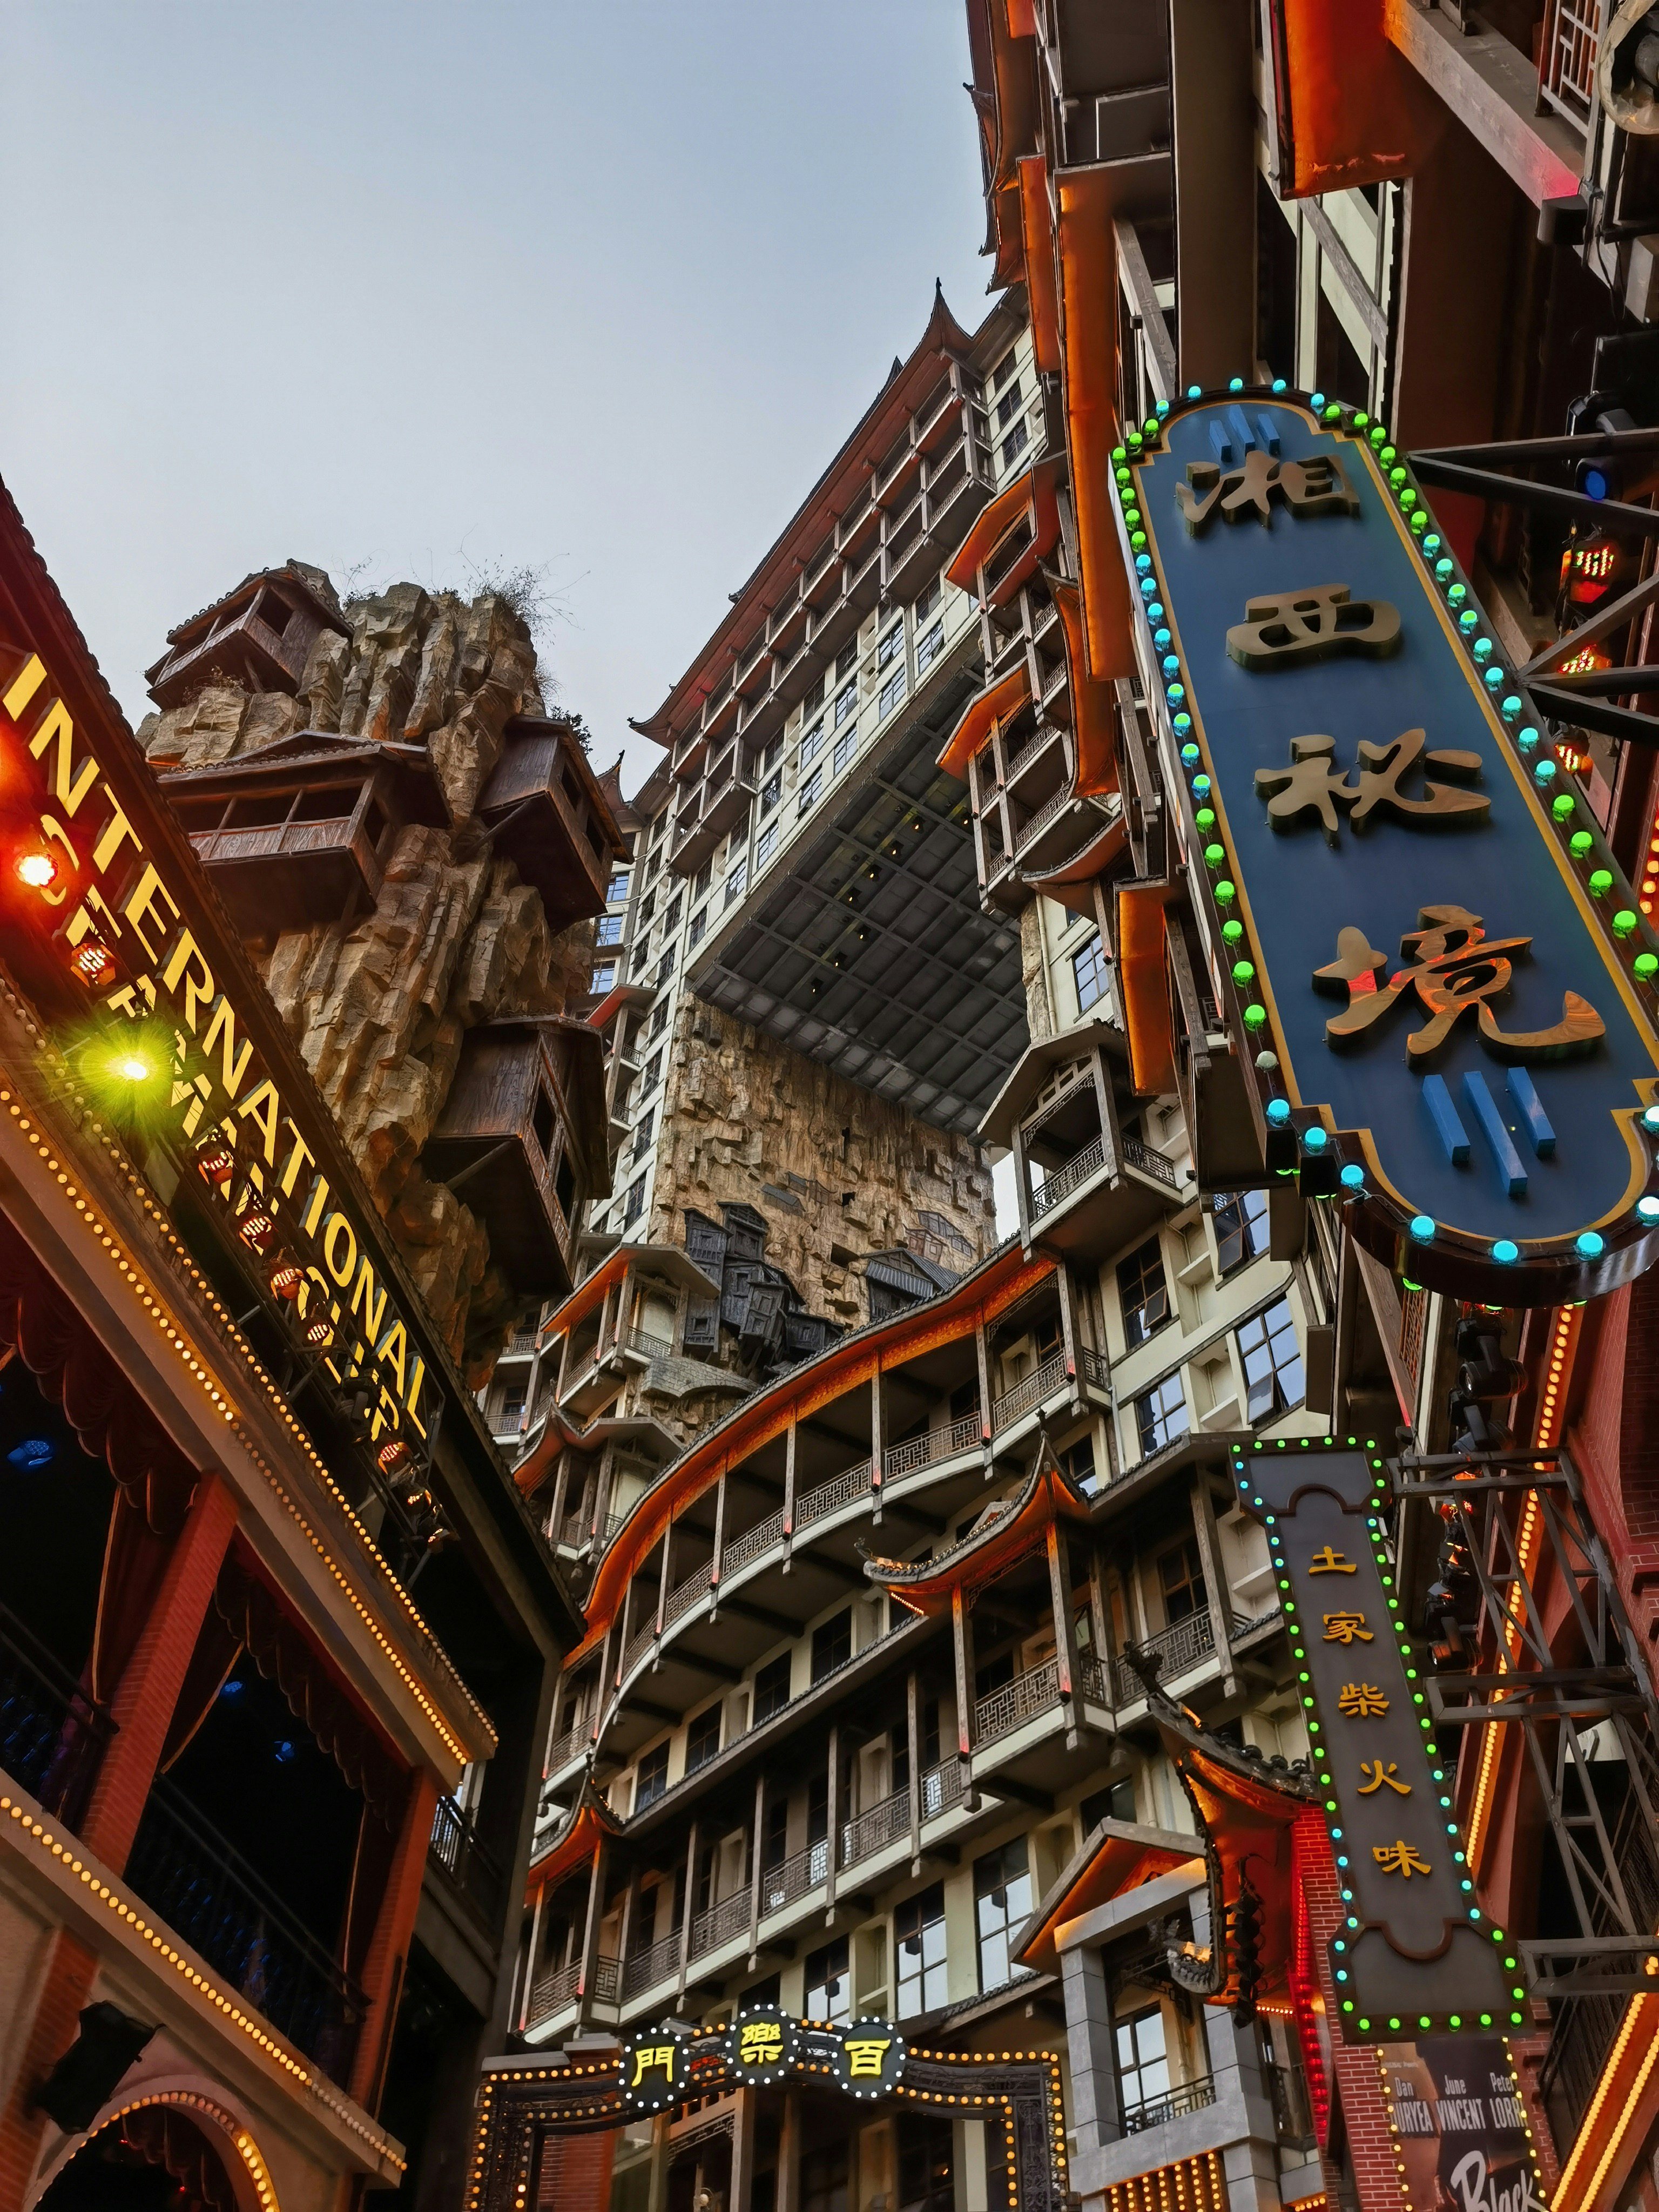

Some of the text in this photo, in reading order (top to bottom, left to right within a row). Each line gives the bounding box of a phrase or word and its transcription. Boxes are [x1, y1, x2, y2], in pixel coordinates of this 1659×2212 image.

[2, 652, 427, 1440] INTERNATIONAL
[1309, 1546, 1431, 1878] 土家柴火味
[1394, 2072, 1515, 2096] Dan June Peter
[1435, 2099, 1486, 2131] VINCENT
[1451, 2150, 1549, 2212] Black
